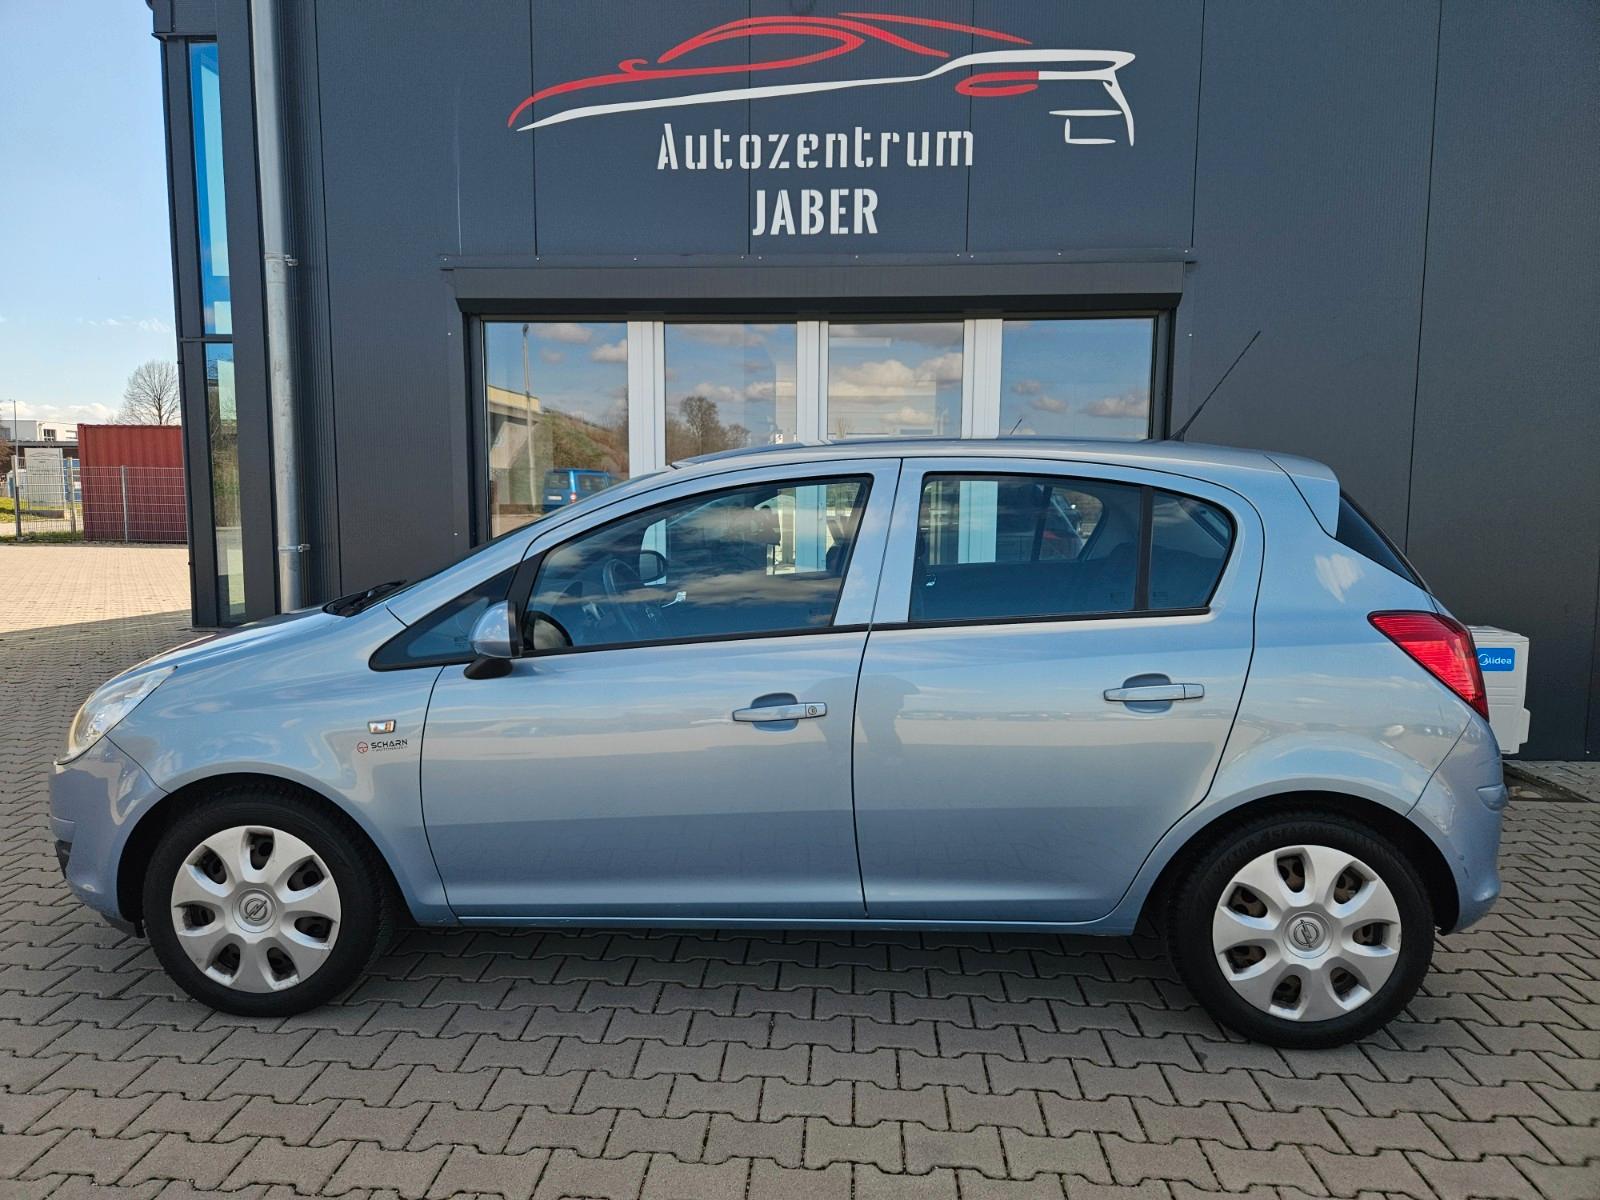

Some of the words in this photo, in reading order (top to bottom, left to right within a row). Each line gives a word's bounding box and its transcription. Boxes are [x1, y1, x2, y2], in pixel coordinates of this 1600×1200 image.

[658, 124, 974, 170] Autozentrum
[752, 189, 878, 236] JABER
[1479, 653, 1512, 666] Midea
[370, 739, 408, 749] SCHARN
